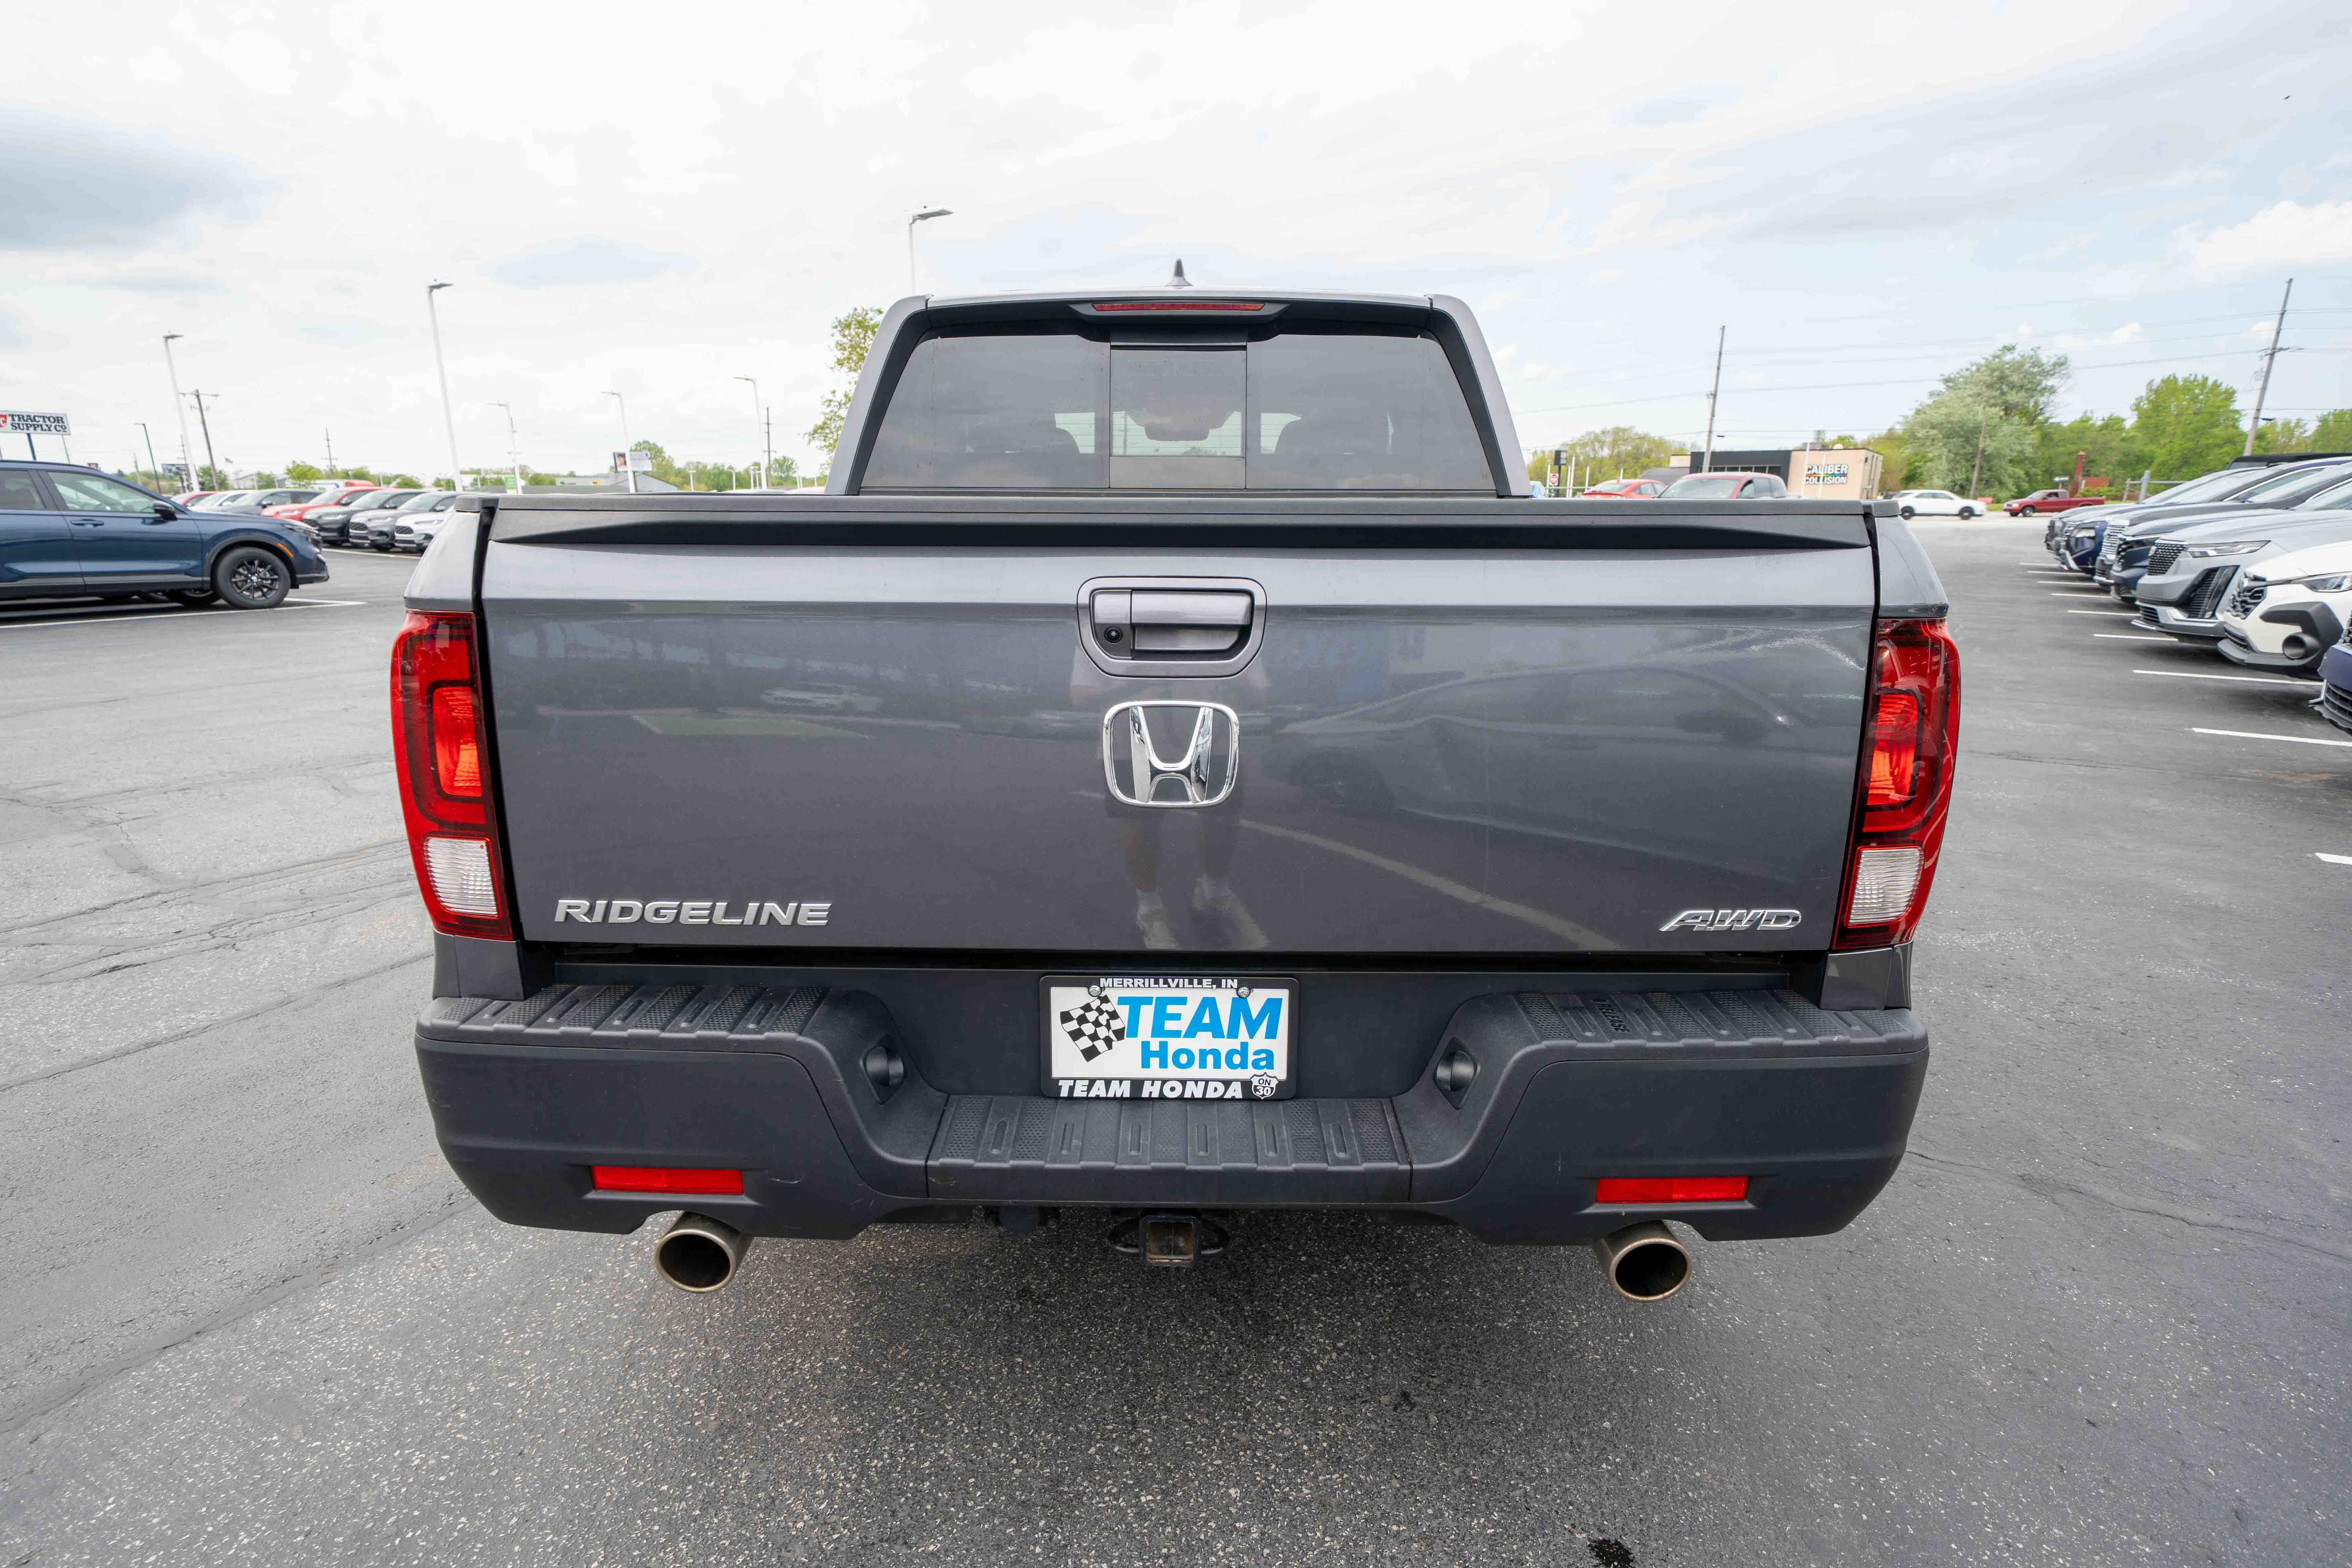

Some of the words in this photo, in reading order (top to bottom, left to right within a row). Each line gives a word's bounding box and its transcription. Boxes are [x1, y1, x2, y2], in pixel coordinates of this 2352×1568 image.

[8, 414, 65, 424] TRACTOR
[11, 422, 52, 431] SUPPLY
[1806, 464, 1848, 474] CALIBER
[554, 900, 832, 926] RIDGELINE
[1659, 909, 1802, 931] AWD
[1100, 978, 1217, 990] MERRILLVILLE,
[1222, 979, 1238, 989] IN
[1117, 997, 1283, 1039] TEAM
[1594, 1003, 1630, 1032] RELEASE
[1141, 1041, 1274, 1070] Honda
[1058, 1080, 1130, 1097] TEAM
[1142, 1080, 1243, 1098] HONDA
[1256, 1086, 1271, 1096] 30
